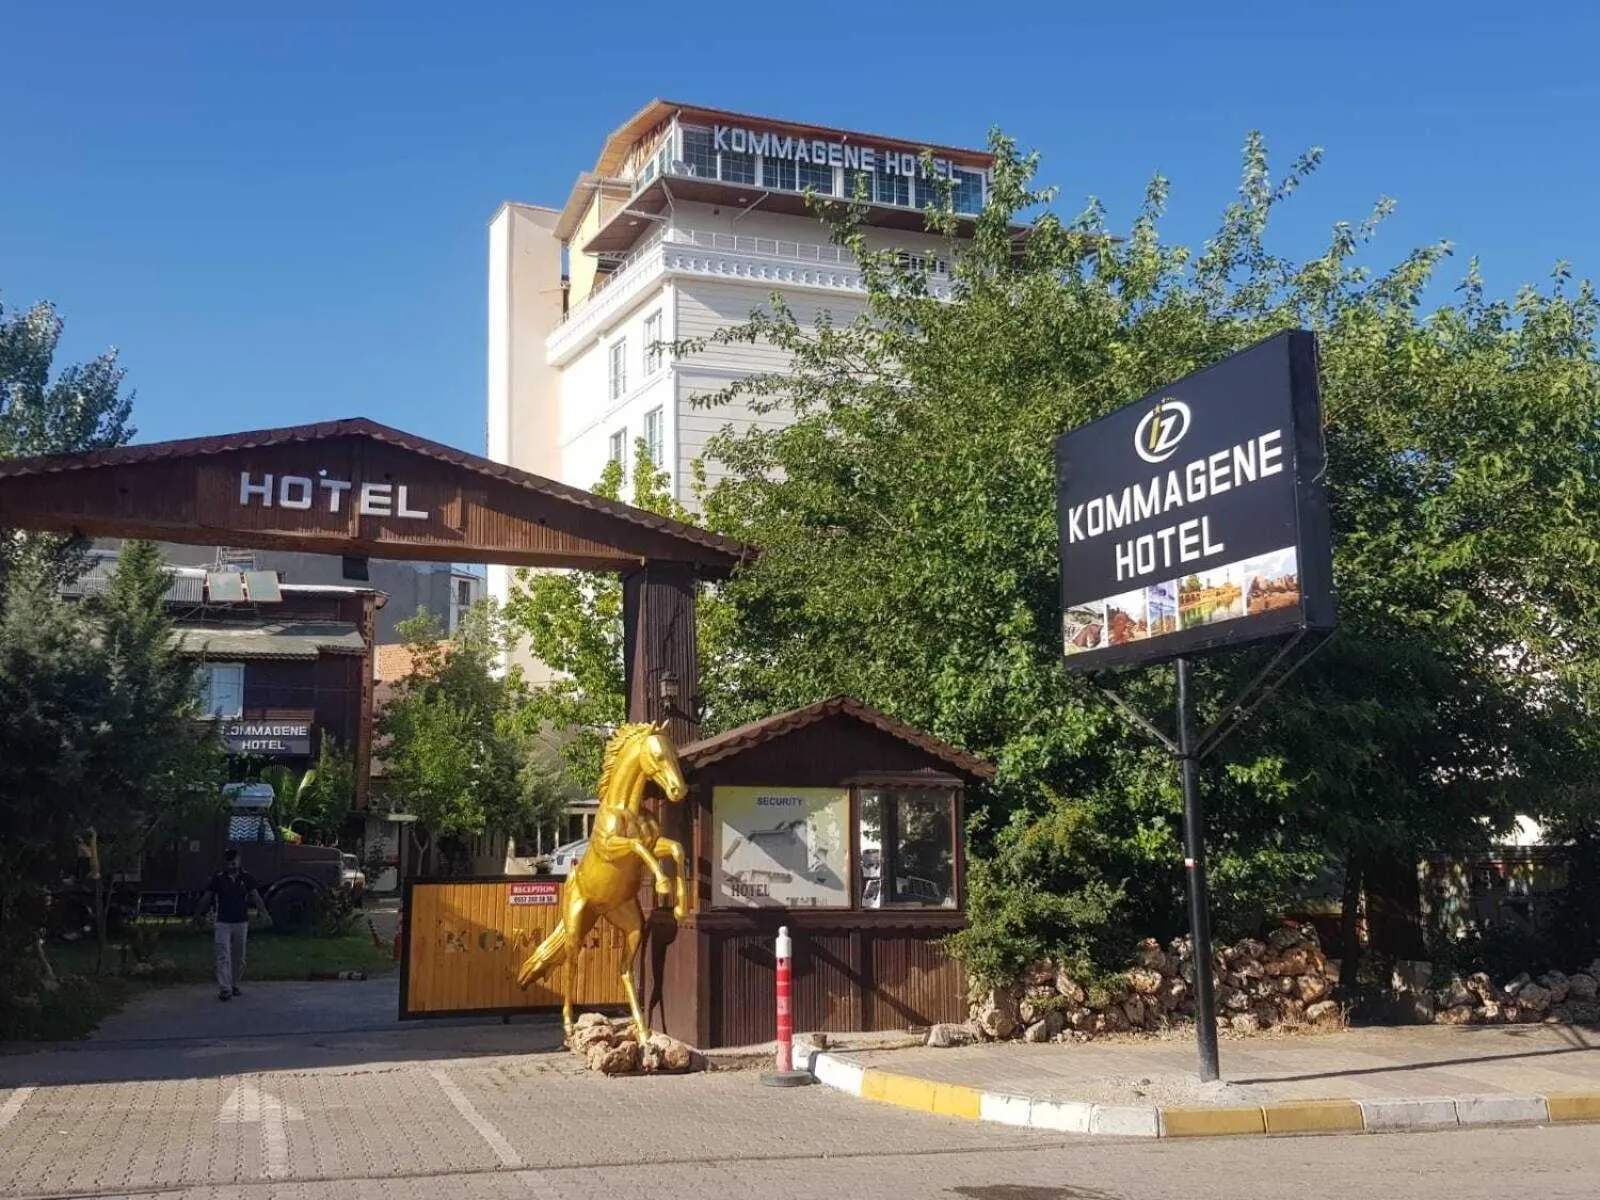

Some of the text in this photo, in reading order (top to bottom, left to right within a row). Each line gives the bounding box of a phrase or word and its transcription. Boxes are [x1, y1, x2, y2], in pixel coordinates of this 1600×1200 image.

[713, 125, 876, 172] KOMMAGENE
[239, 472, 429, 519] HOTEL
[1068, 429, 1283, 544] KOMMAGENE
[1116, 516, 1225, 582] HOTEL
[241, 740, 286, 750] HOTEL
[757, 797, 804, 806] SECURITY
[513, 885, 556, 894] RECEPTION
[731, 884, 770, 897] HOTEL
